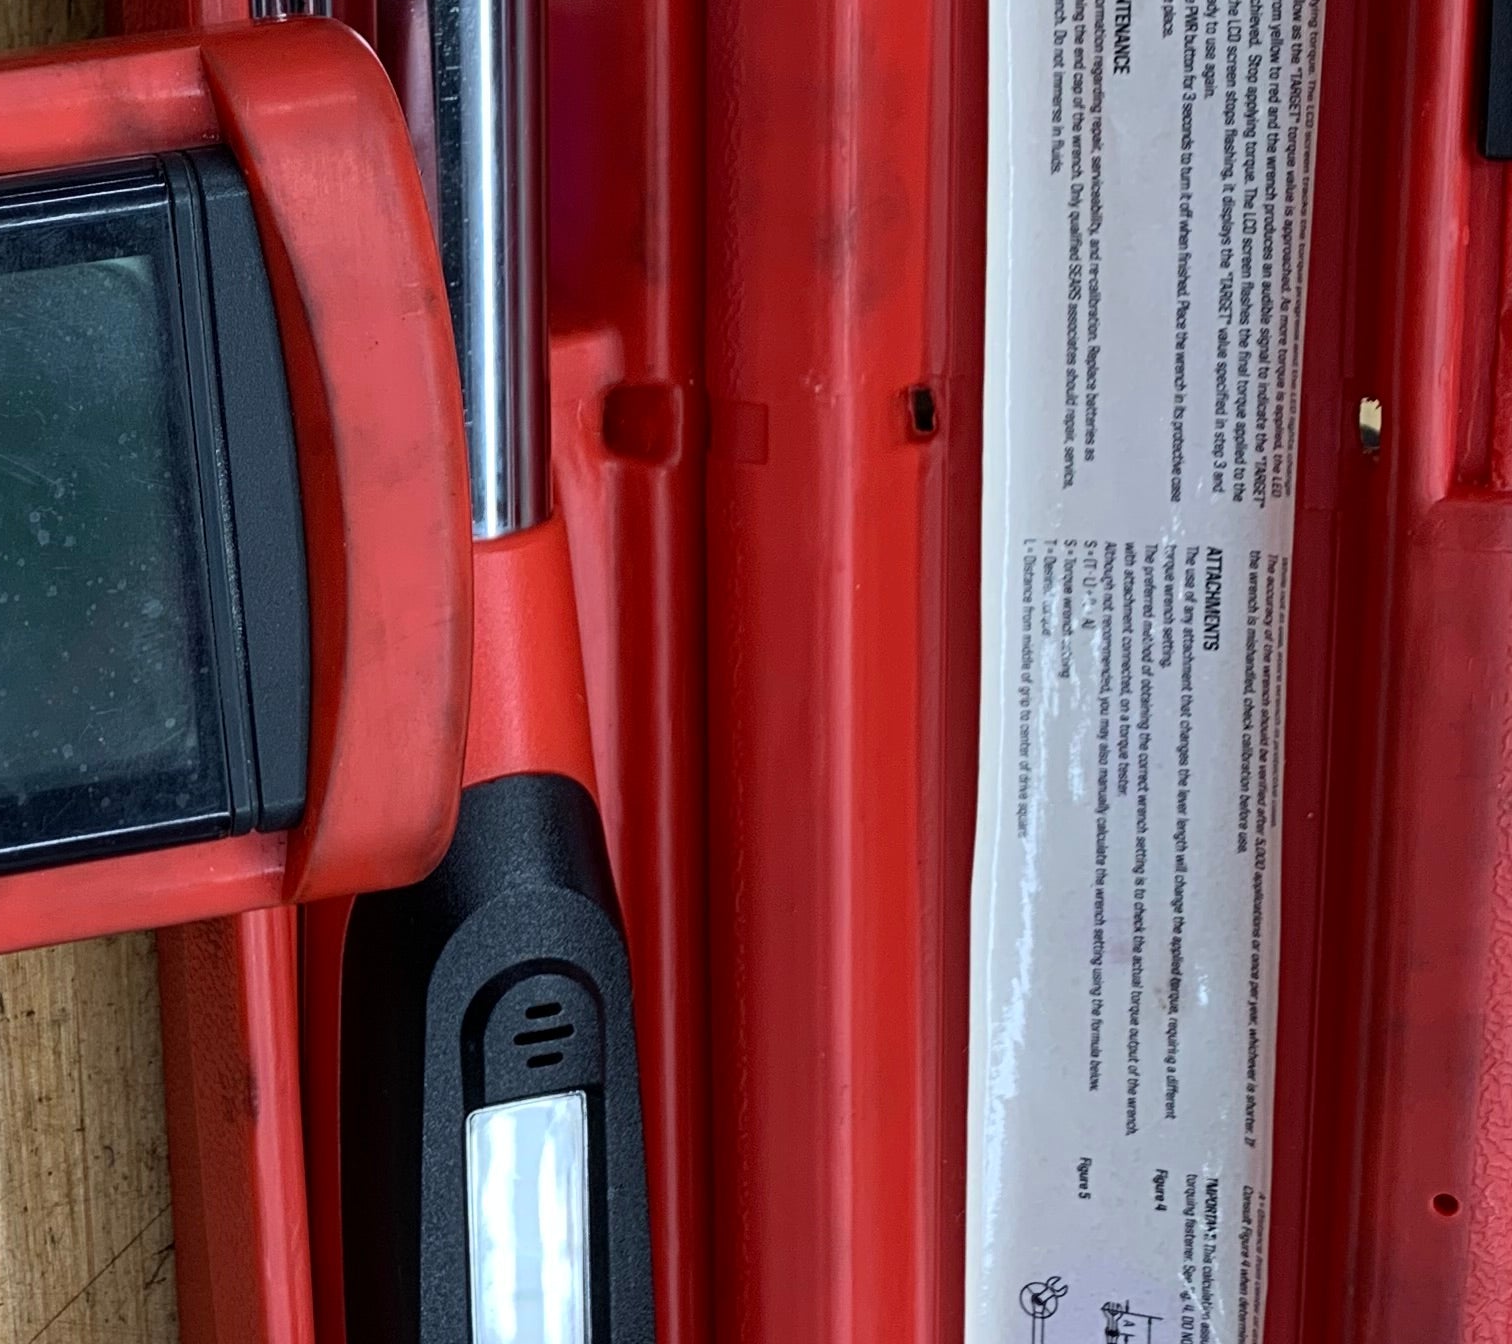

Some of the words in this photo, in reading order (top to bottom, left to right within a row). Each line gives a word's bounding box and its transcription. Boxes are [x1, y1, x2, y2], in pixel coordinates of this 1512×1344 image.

[1203, 546, 1224, 651] ATTACHMENTS
[1077, 1157, 1093, 1190] Figure
[1152, 1168, 1169, 1202] Figure
[1078, 1191, 1092, 1200] 5
[1155, 1203, 1168, 1212] 4
